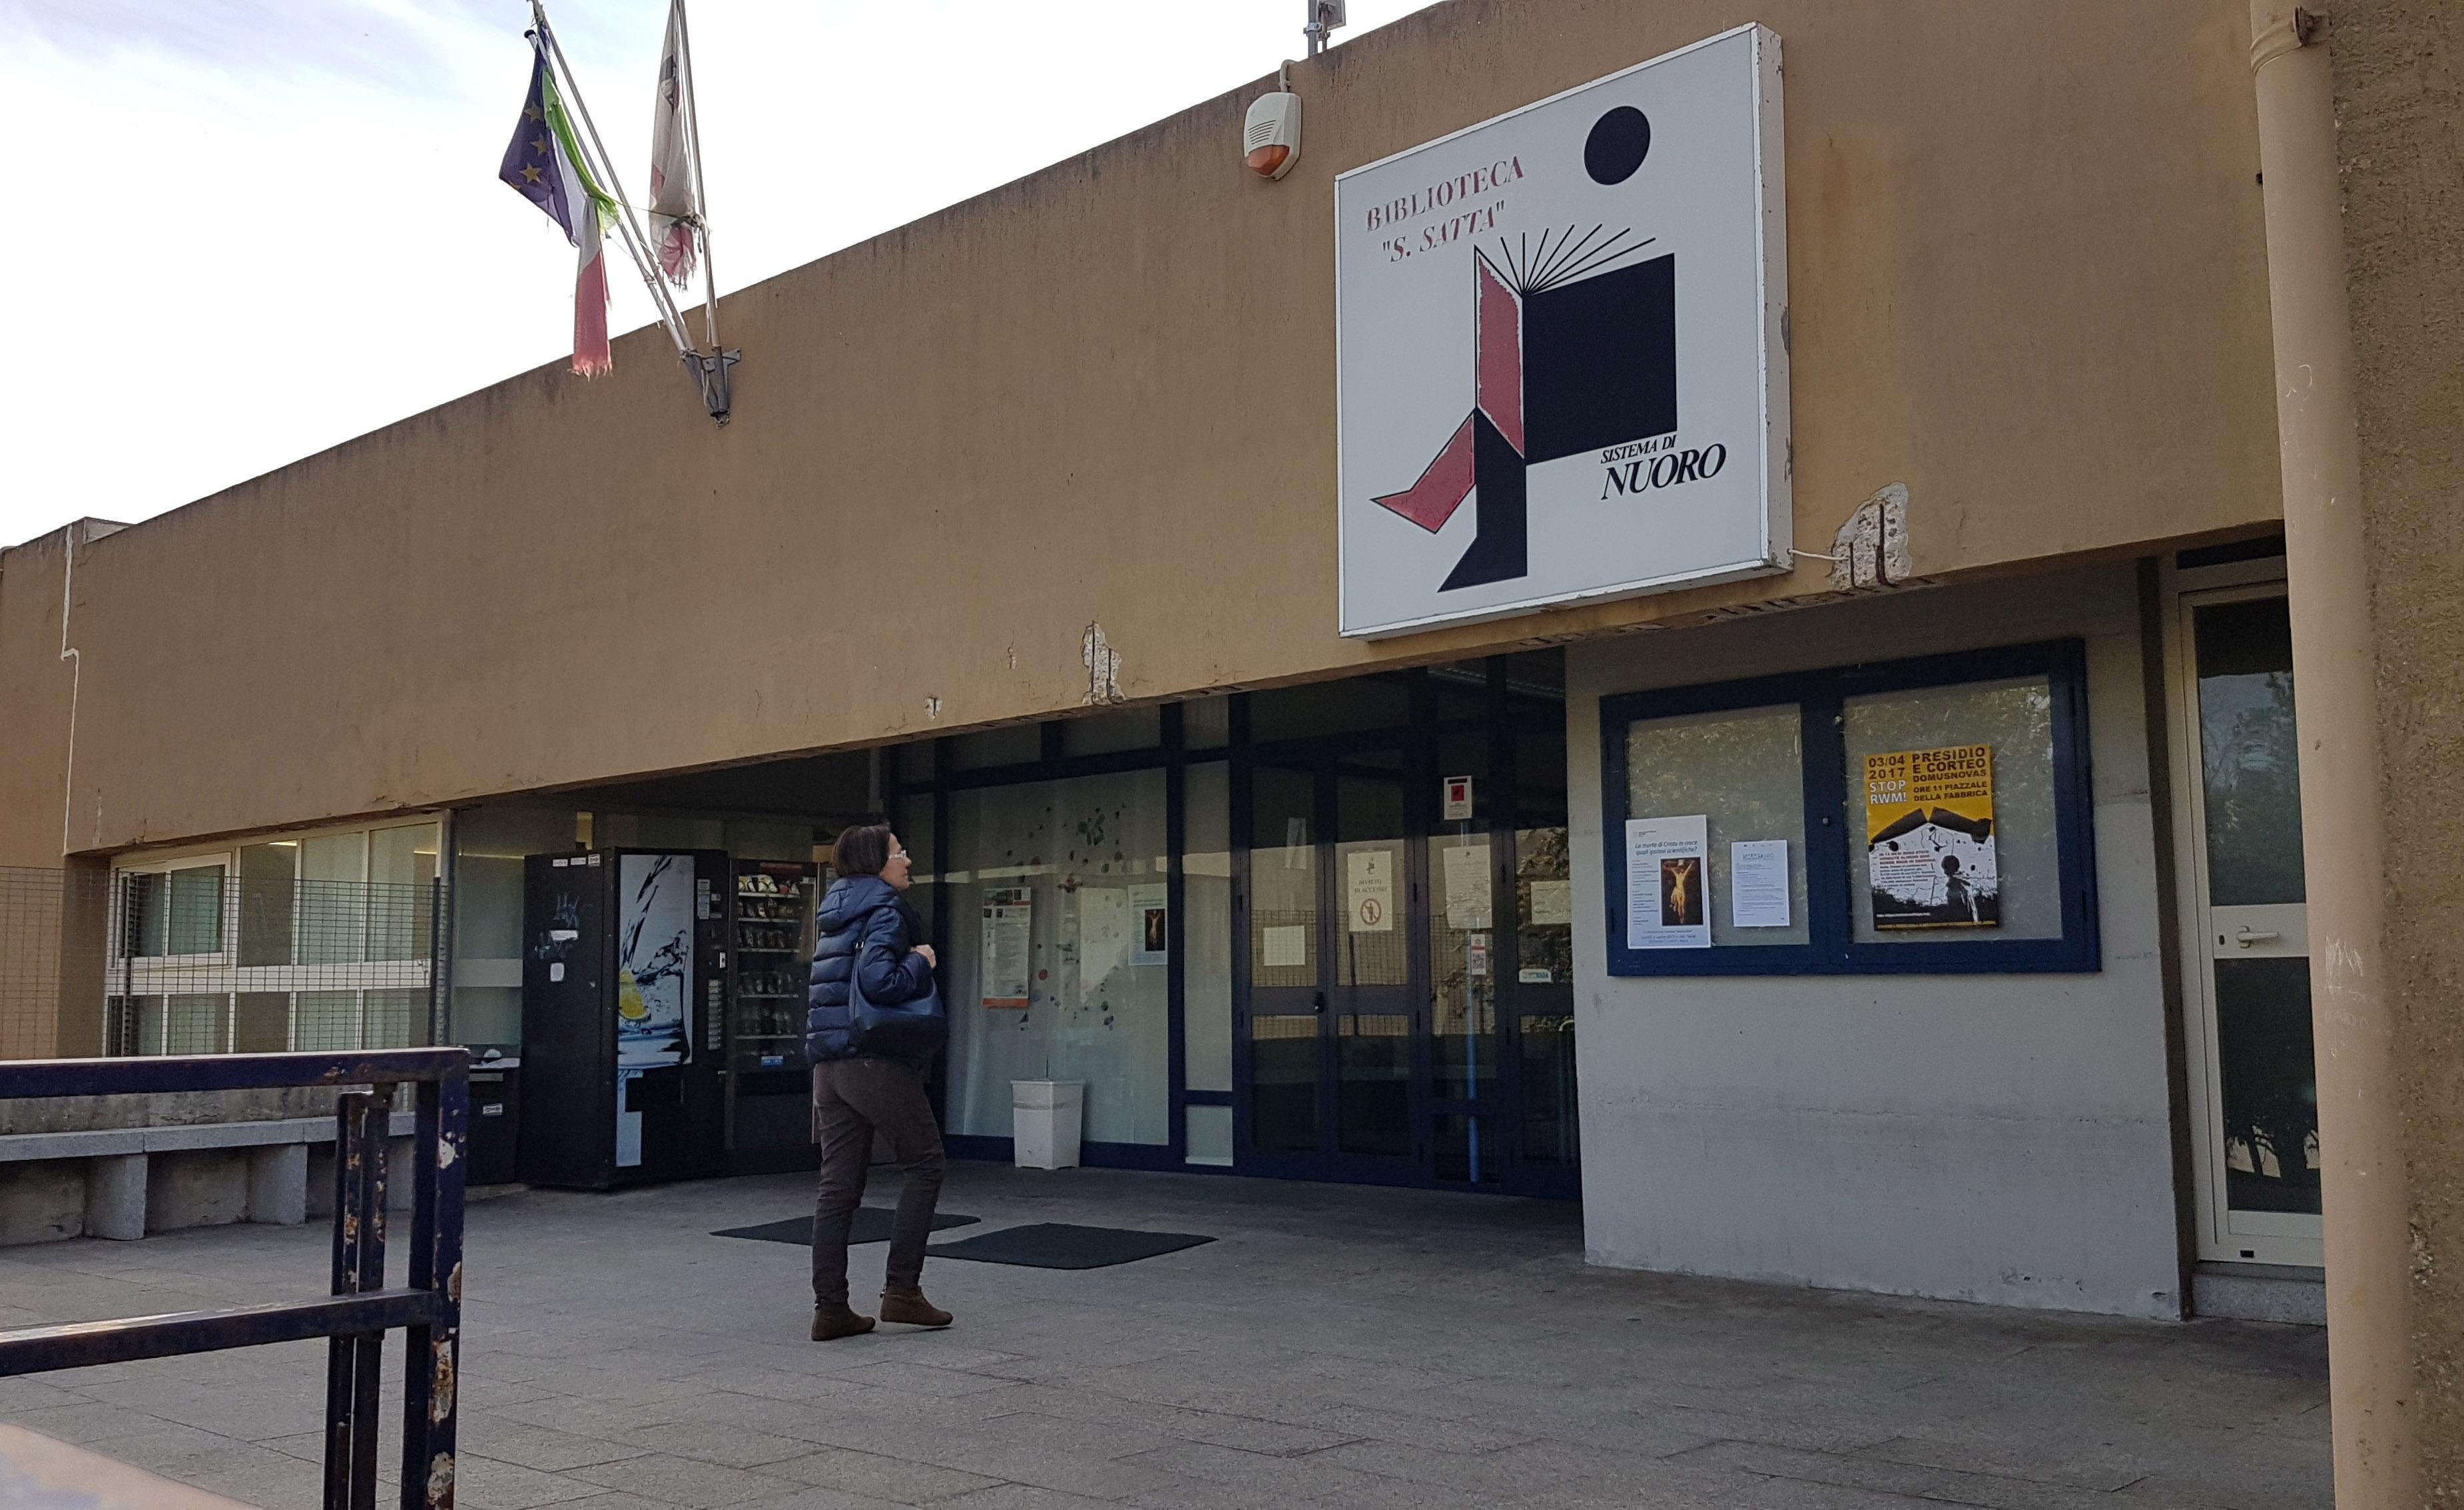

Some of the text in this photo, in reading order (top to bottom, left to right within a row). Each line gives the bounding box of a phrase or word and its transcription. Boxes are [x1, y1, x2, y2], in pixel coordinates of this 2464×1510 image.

[1366, 156, 1524, 233] BIBLIOTECA
[1383, 200, 1504, 262] "S. SATTA"
[1600, 434, 1677, 463] SISTEMA DI
[1601, 443, 1727, 500] NUORO
[1869, 755, 1905, 768] 03/04
[1912, 747, 1985, 763] PRESIDIO
[1913, 758, 1986, 774] E CORTEO
[1869, 768, 1905, 780] 2017
[1913, 770, 1987, 782] DOMUSNOVAS
[1869, 780, 1907, 792] STOP
[1945, 781, 1987, 791] PIAZZALE
[1871, 792, 1907, 805] RWM!
[1945, 790, 1988, 799] FABBRICA
